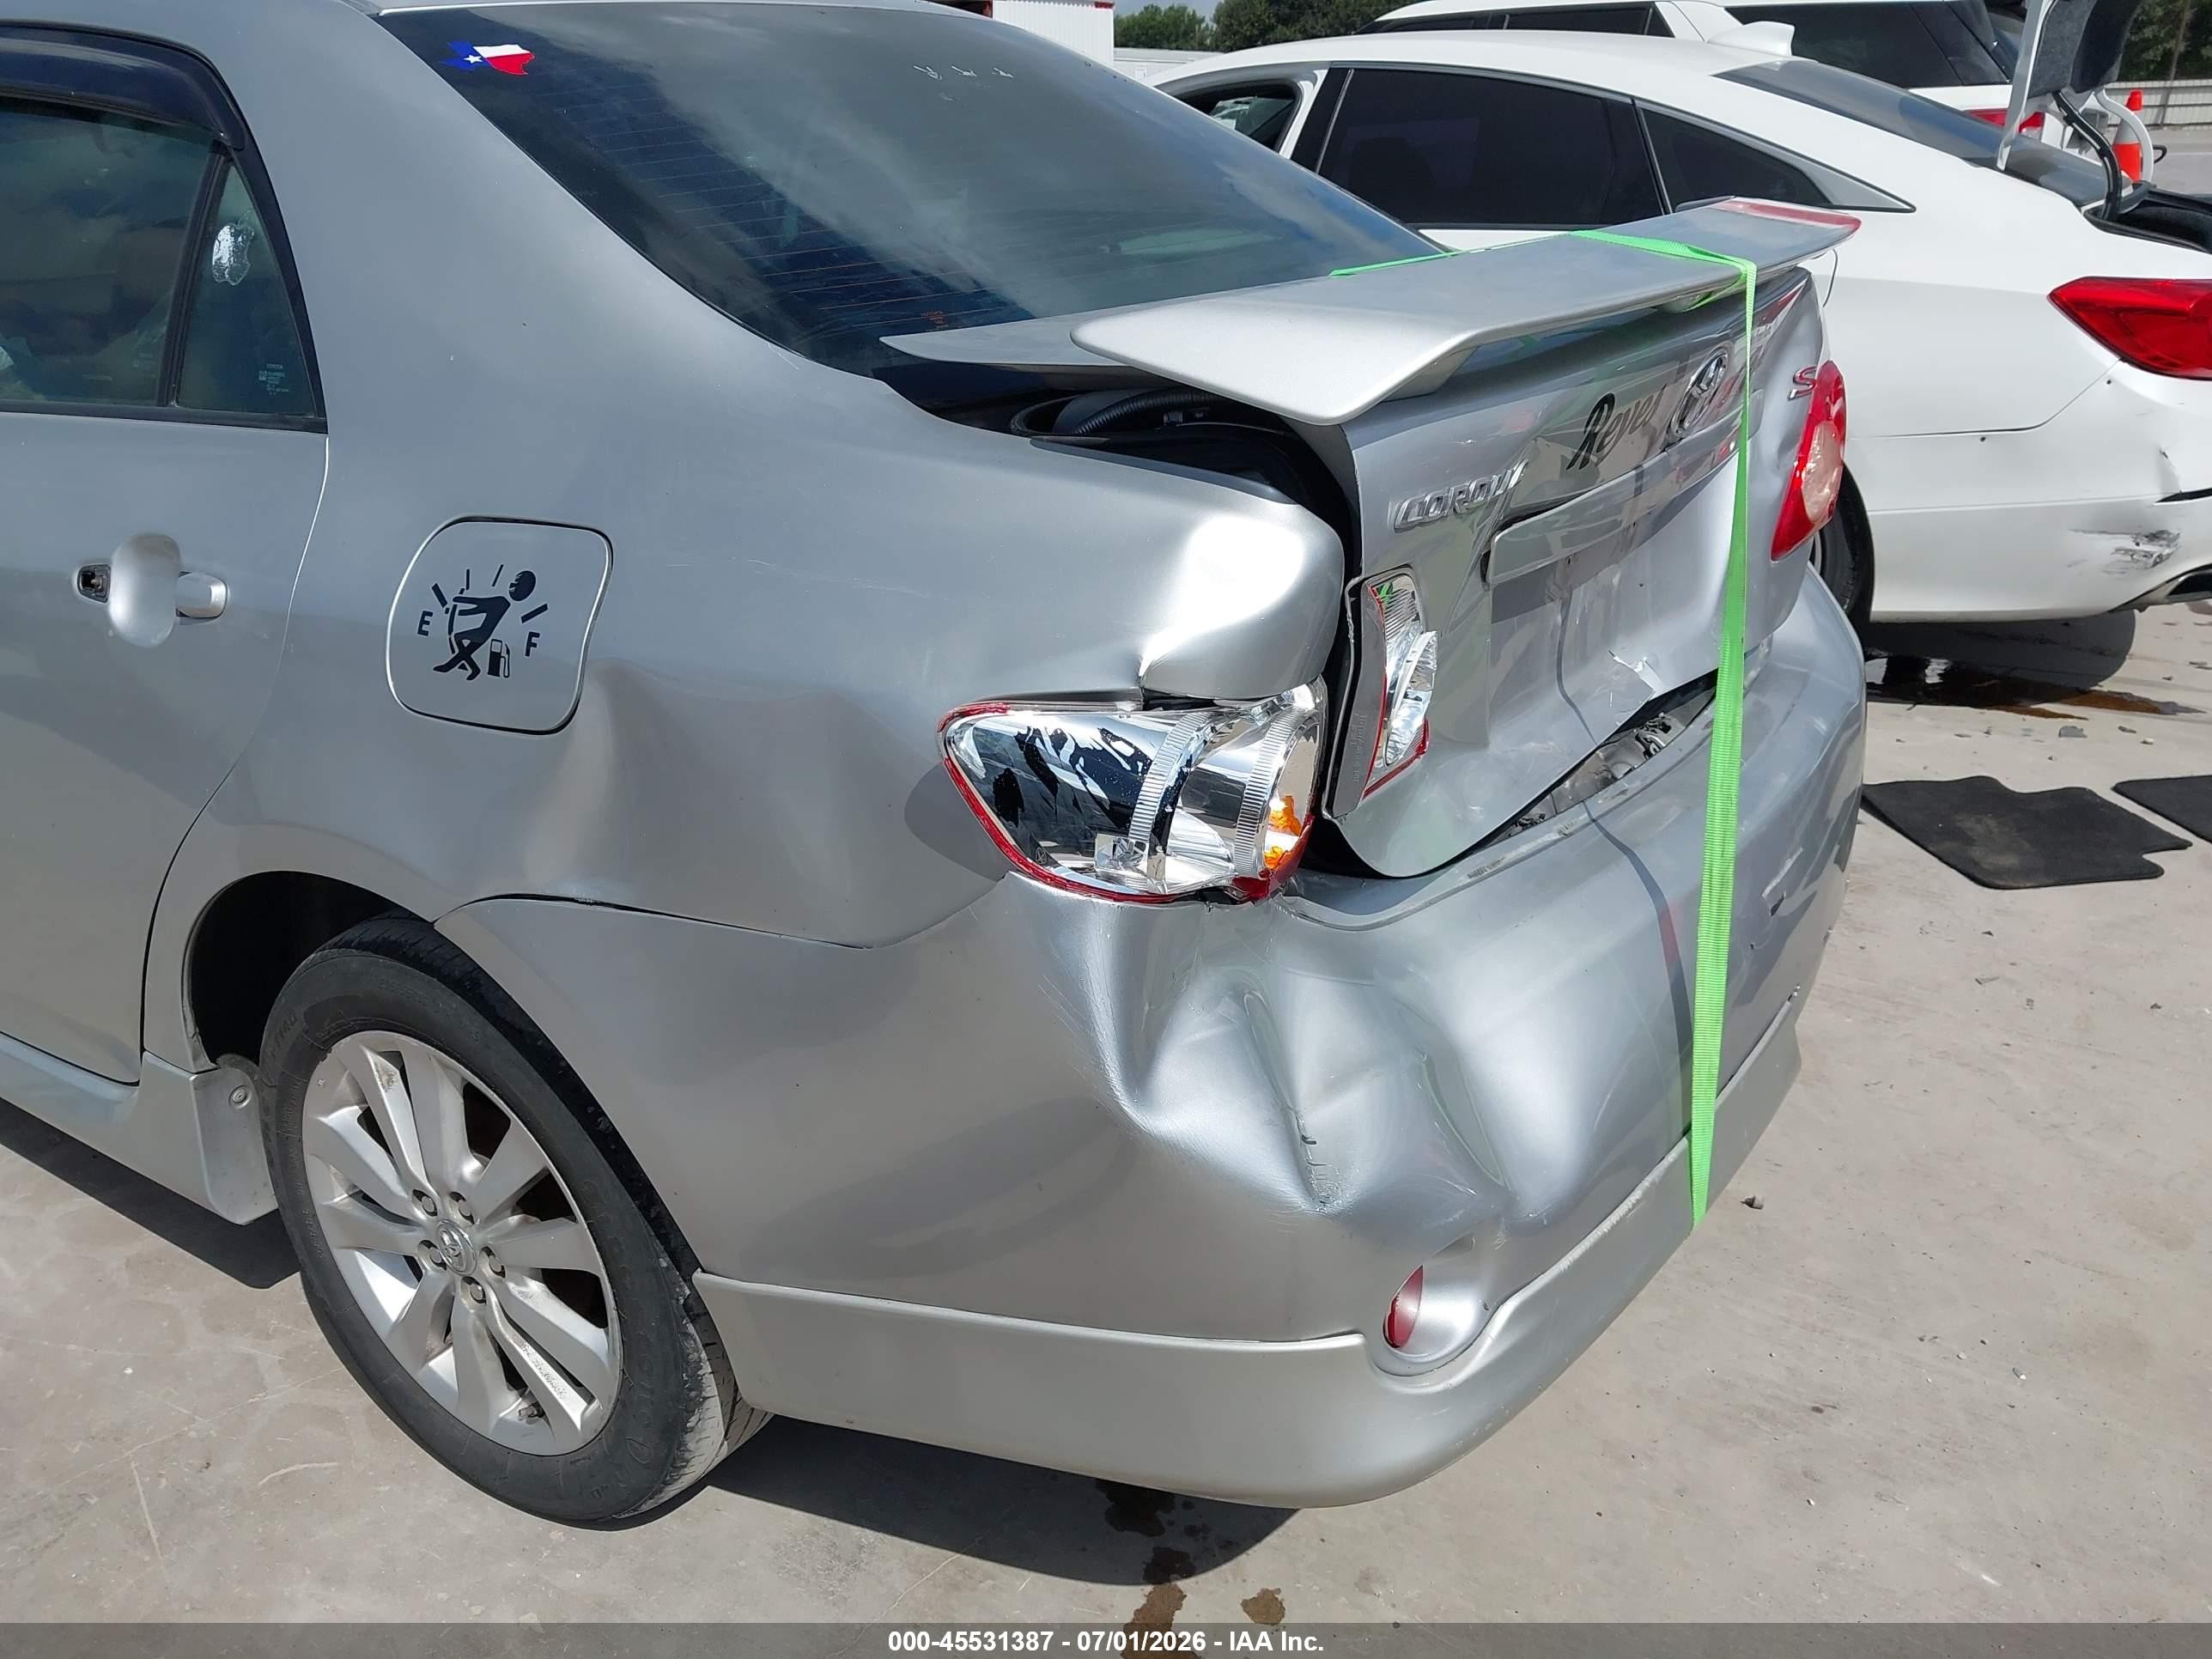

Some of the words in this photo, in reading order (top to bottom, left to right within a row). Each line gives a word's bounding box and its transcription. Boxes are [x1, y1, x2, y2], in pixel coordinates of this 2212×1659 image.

[1788, 365, 1818, 401] S
[1565, 384, 1667, 471] Reyes
[417, 610, 433, 637] E
[525, 631, 540, 657] F
